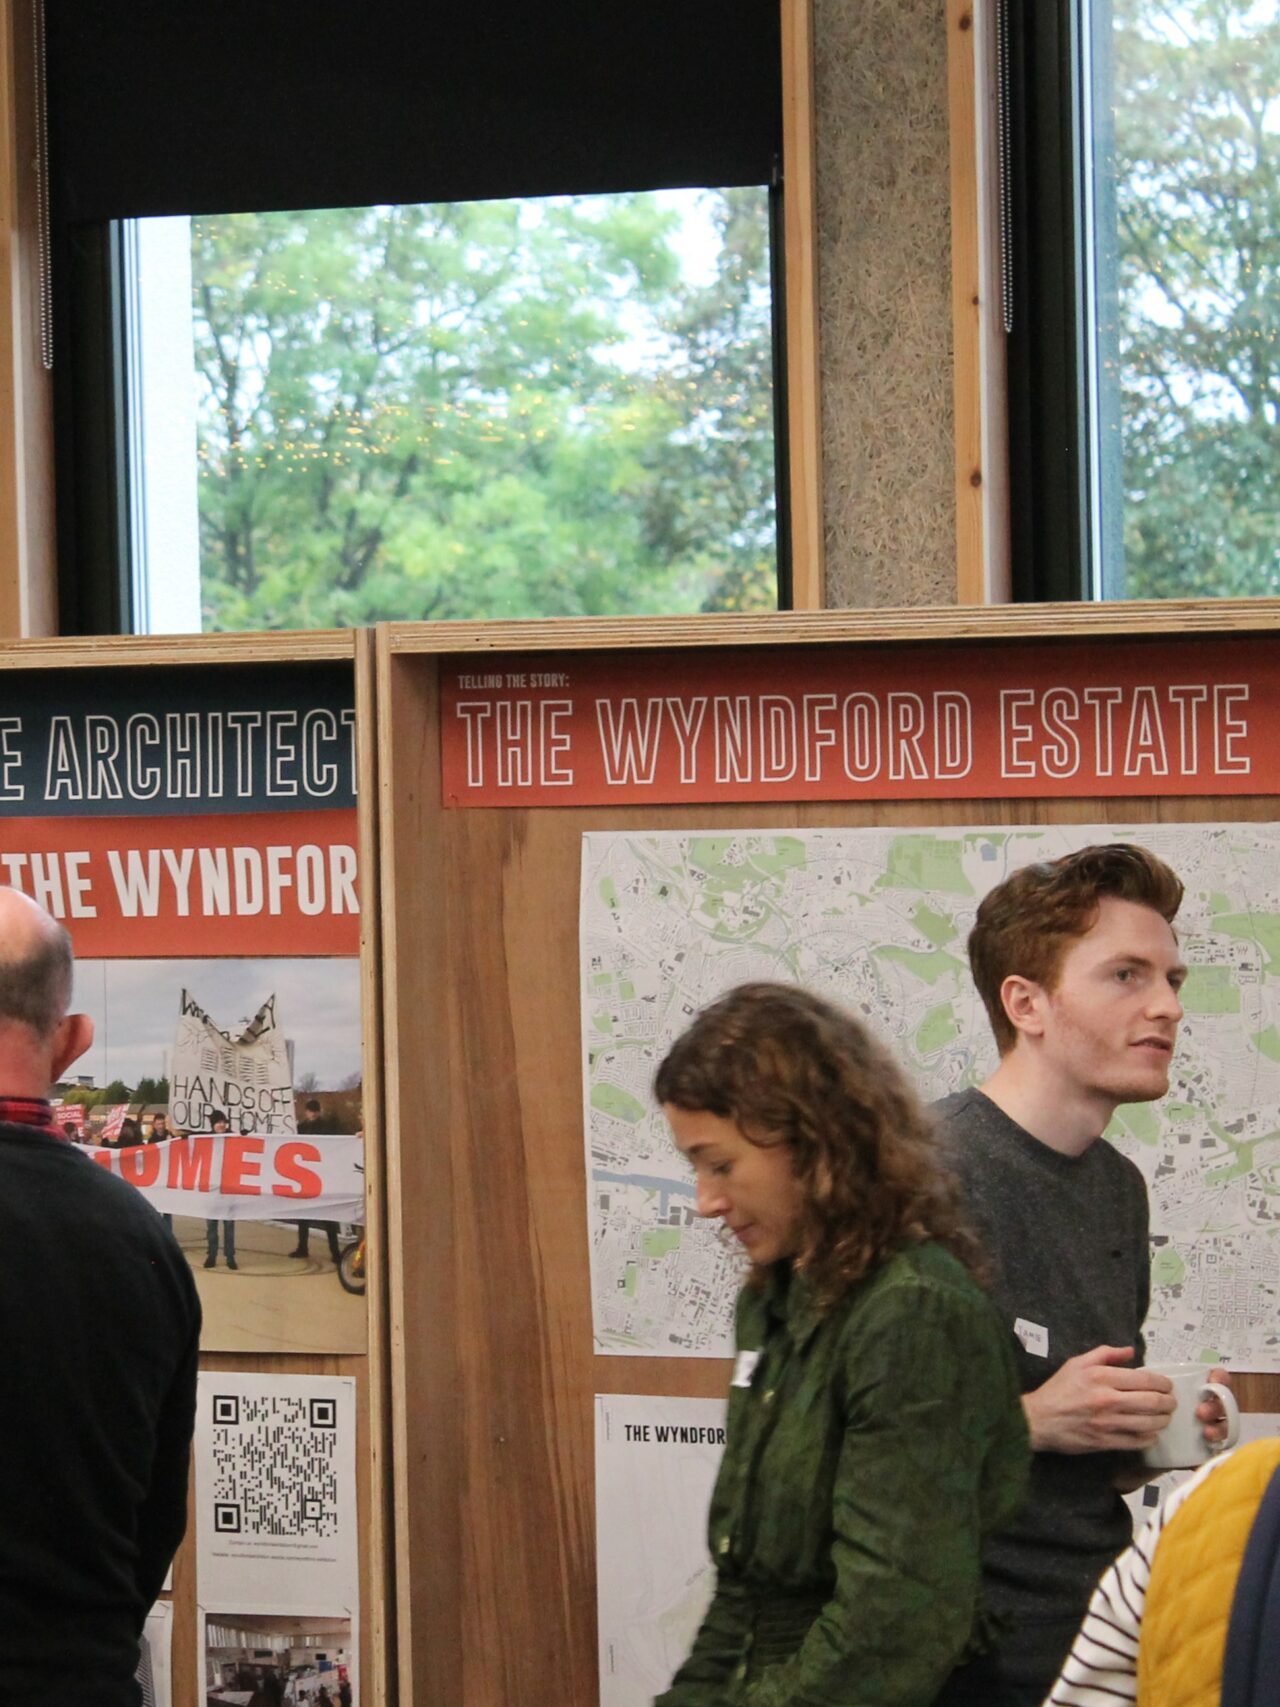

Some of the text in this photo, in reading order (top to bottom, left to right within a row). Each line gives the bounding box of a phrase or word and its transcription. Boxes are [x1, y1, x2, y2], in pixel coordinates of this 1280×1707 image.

[458, 672, 570, 689] TELLING THE STORY:
[456, 684, 1251, 787] THE WYNDFORD ESTATE
[1, 850, 98, 919] THE
[173, 1074, 292, 1113] HANDS OFF
[173, 1101, 296, 1135] OUR HOMES
[624, 1424, 651, 1442] THE
[655, 1425, 726, 1445] WYNDFOR
